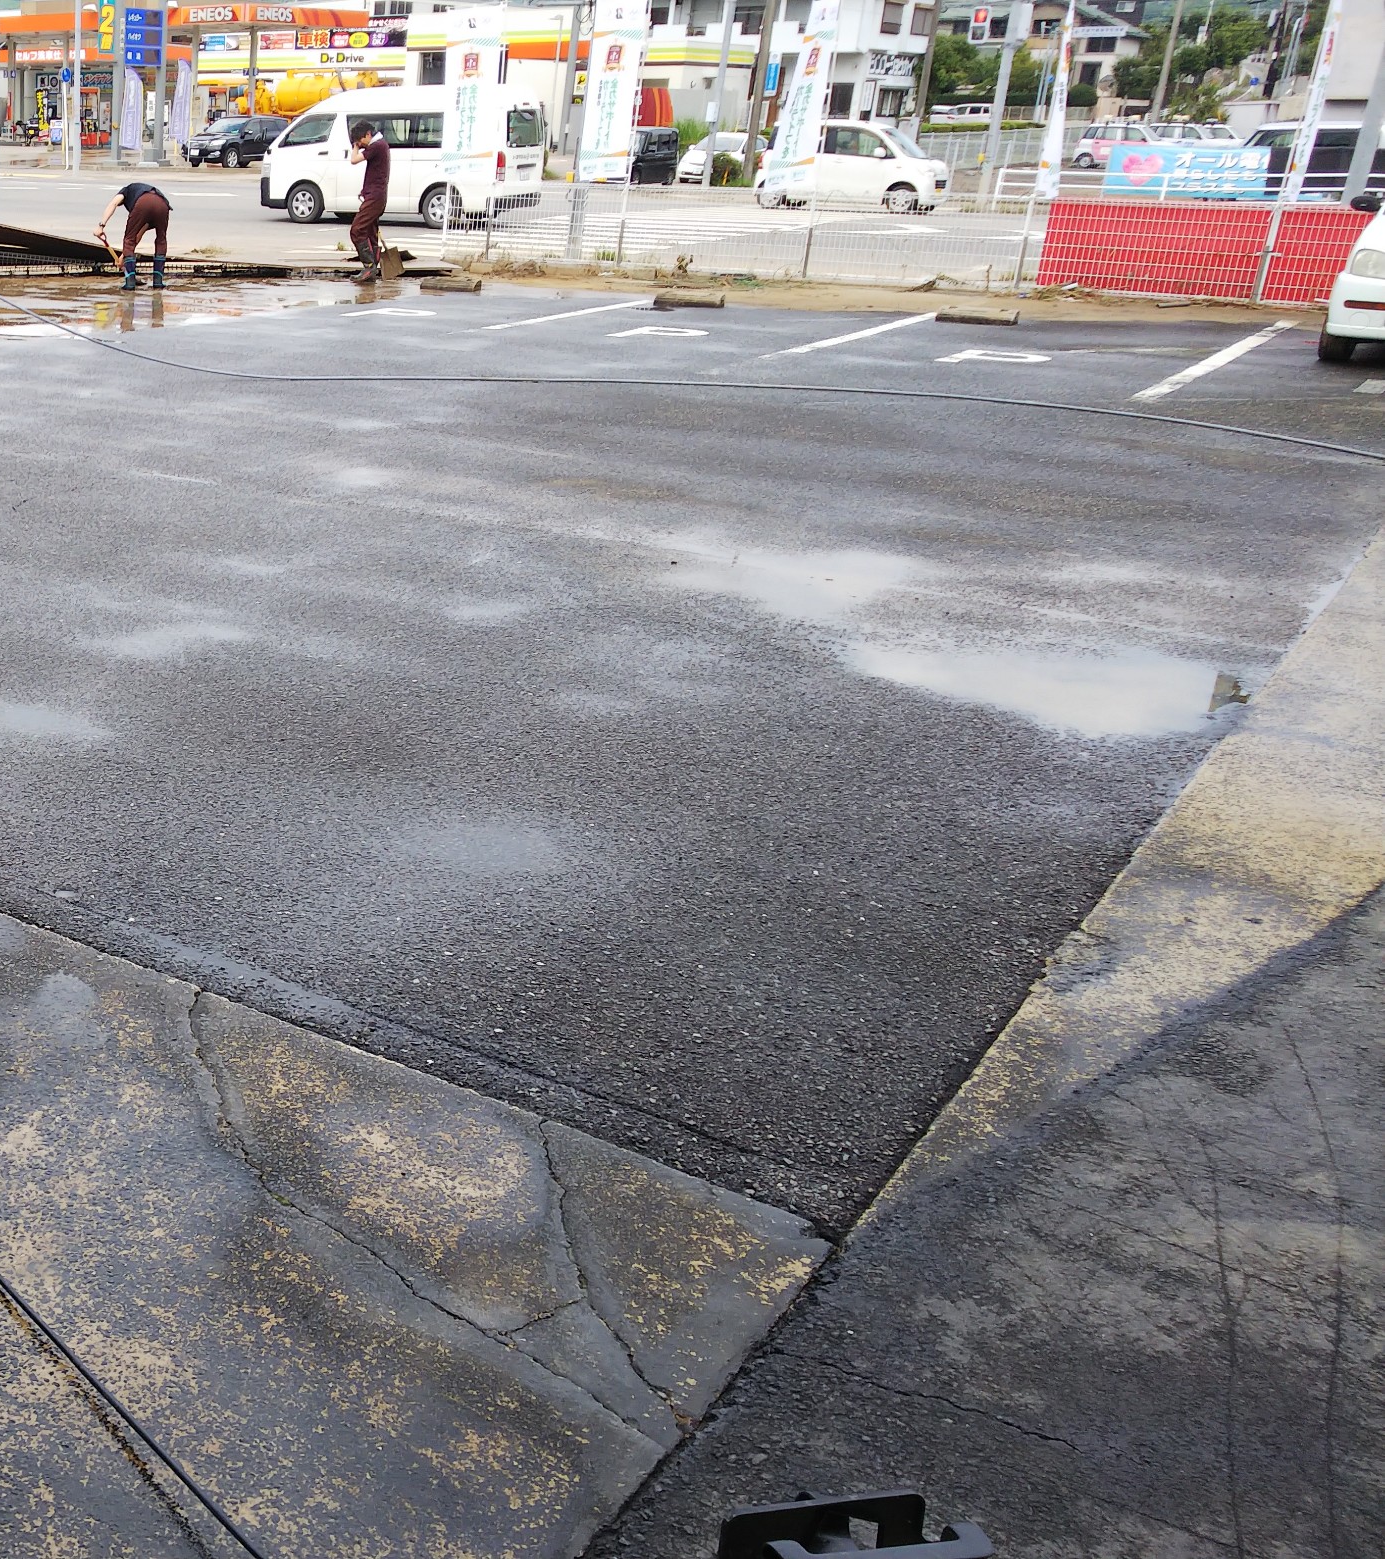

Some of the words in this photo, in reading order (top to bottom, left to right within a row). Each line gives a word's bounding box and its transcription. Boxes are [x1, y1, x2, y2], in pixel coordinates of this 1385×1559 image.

[189, 7, 233, 22] ENEOS
[256, 7, 293, 22] ENEOS
[297, 28, 330, 48] 車検
[320, 52, 334, 63] Dr.
[336, 52, 365, 63] Drive
[606, 325, 710, 338] P
[934, 348, 1053, 363] P
